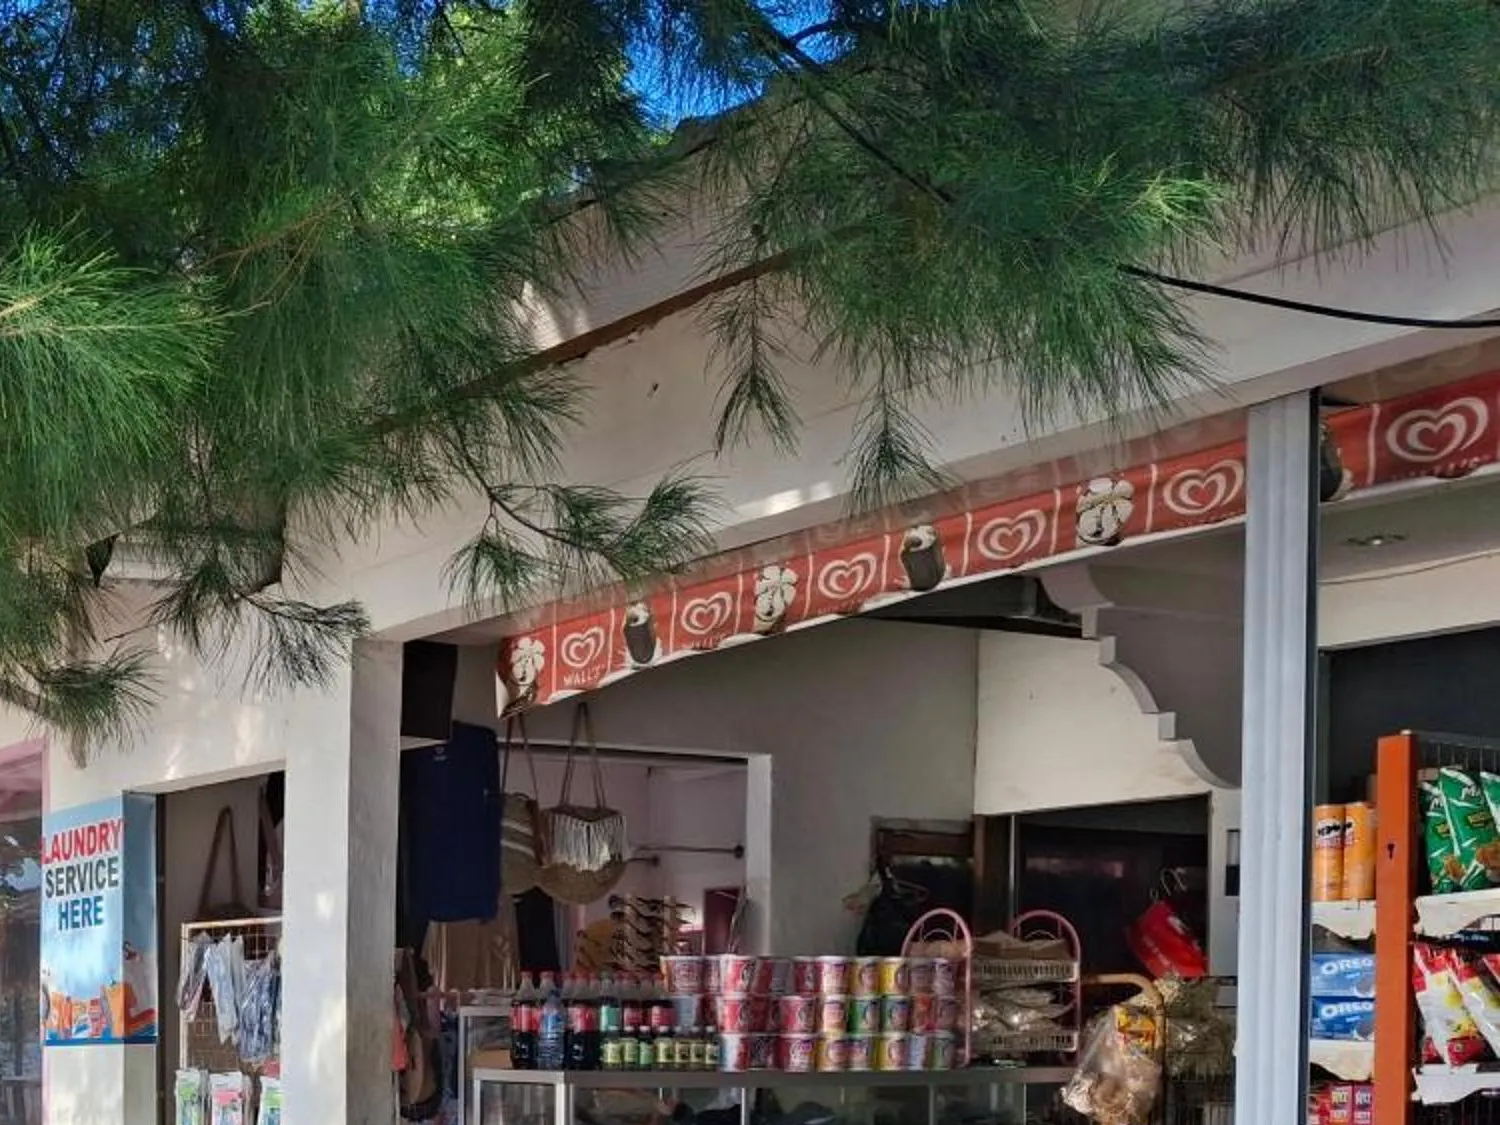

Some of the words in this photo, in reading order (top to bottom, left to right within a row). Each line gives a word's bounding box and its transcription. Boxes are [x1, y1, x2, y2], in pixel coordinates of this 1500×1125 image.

[40, 819, 124, 865] LAUNDRY
[45, 856, 119, 899] SERVICE
[58, 895, 104, 931] HERE
